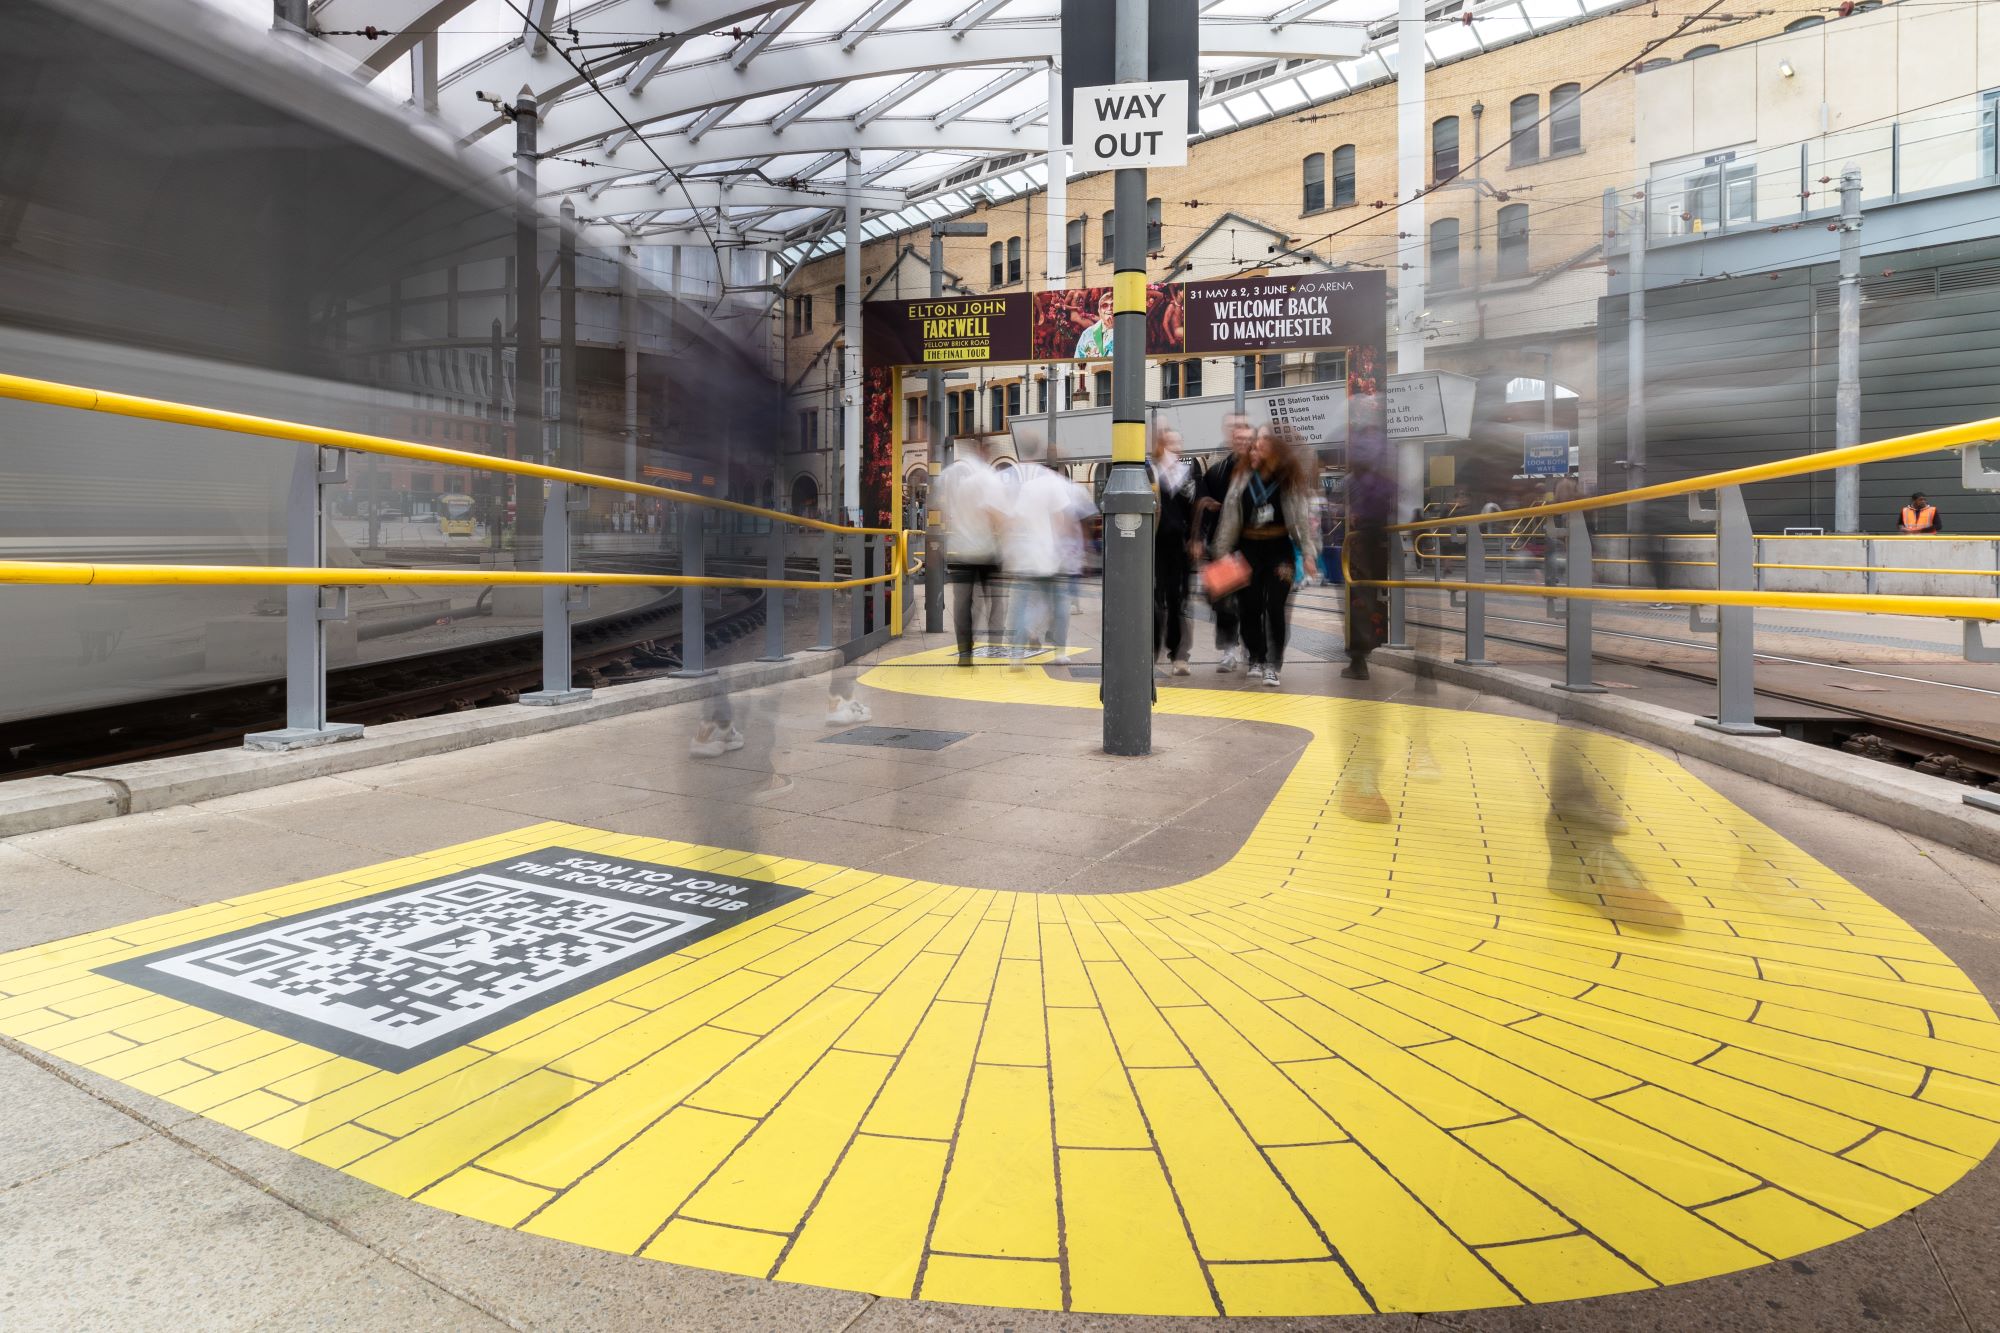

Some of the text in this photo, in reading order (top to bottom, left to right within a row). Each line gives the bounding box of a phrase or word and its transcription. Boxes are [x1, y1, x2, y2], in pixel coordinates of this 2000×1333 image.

[1094, 93, 1166, 121] WAY
[1094, 131, 1163, 158] OUT
[1190, 282, 1354, 299] 31 MAY & 2, 3 JUNE AO ARENA
[908, 301, 1006, 318] ELTON JOHN
[1214, 296, 1328, 320] WELCOME BACK
[924, 318, 990, 338] FAREWELL
[1210, 318, 1332, 340] TO MANCHESTER
[927, 349, 986, 360] THE FINAL TOUR
[1288, 396, 1310, 404] Station
[506, 862, 750, 912] THE ROCKET CLUB
[555, 857, 750, 896] SCAN TO JOIN
